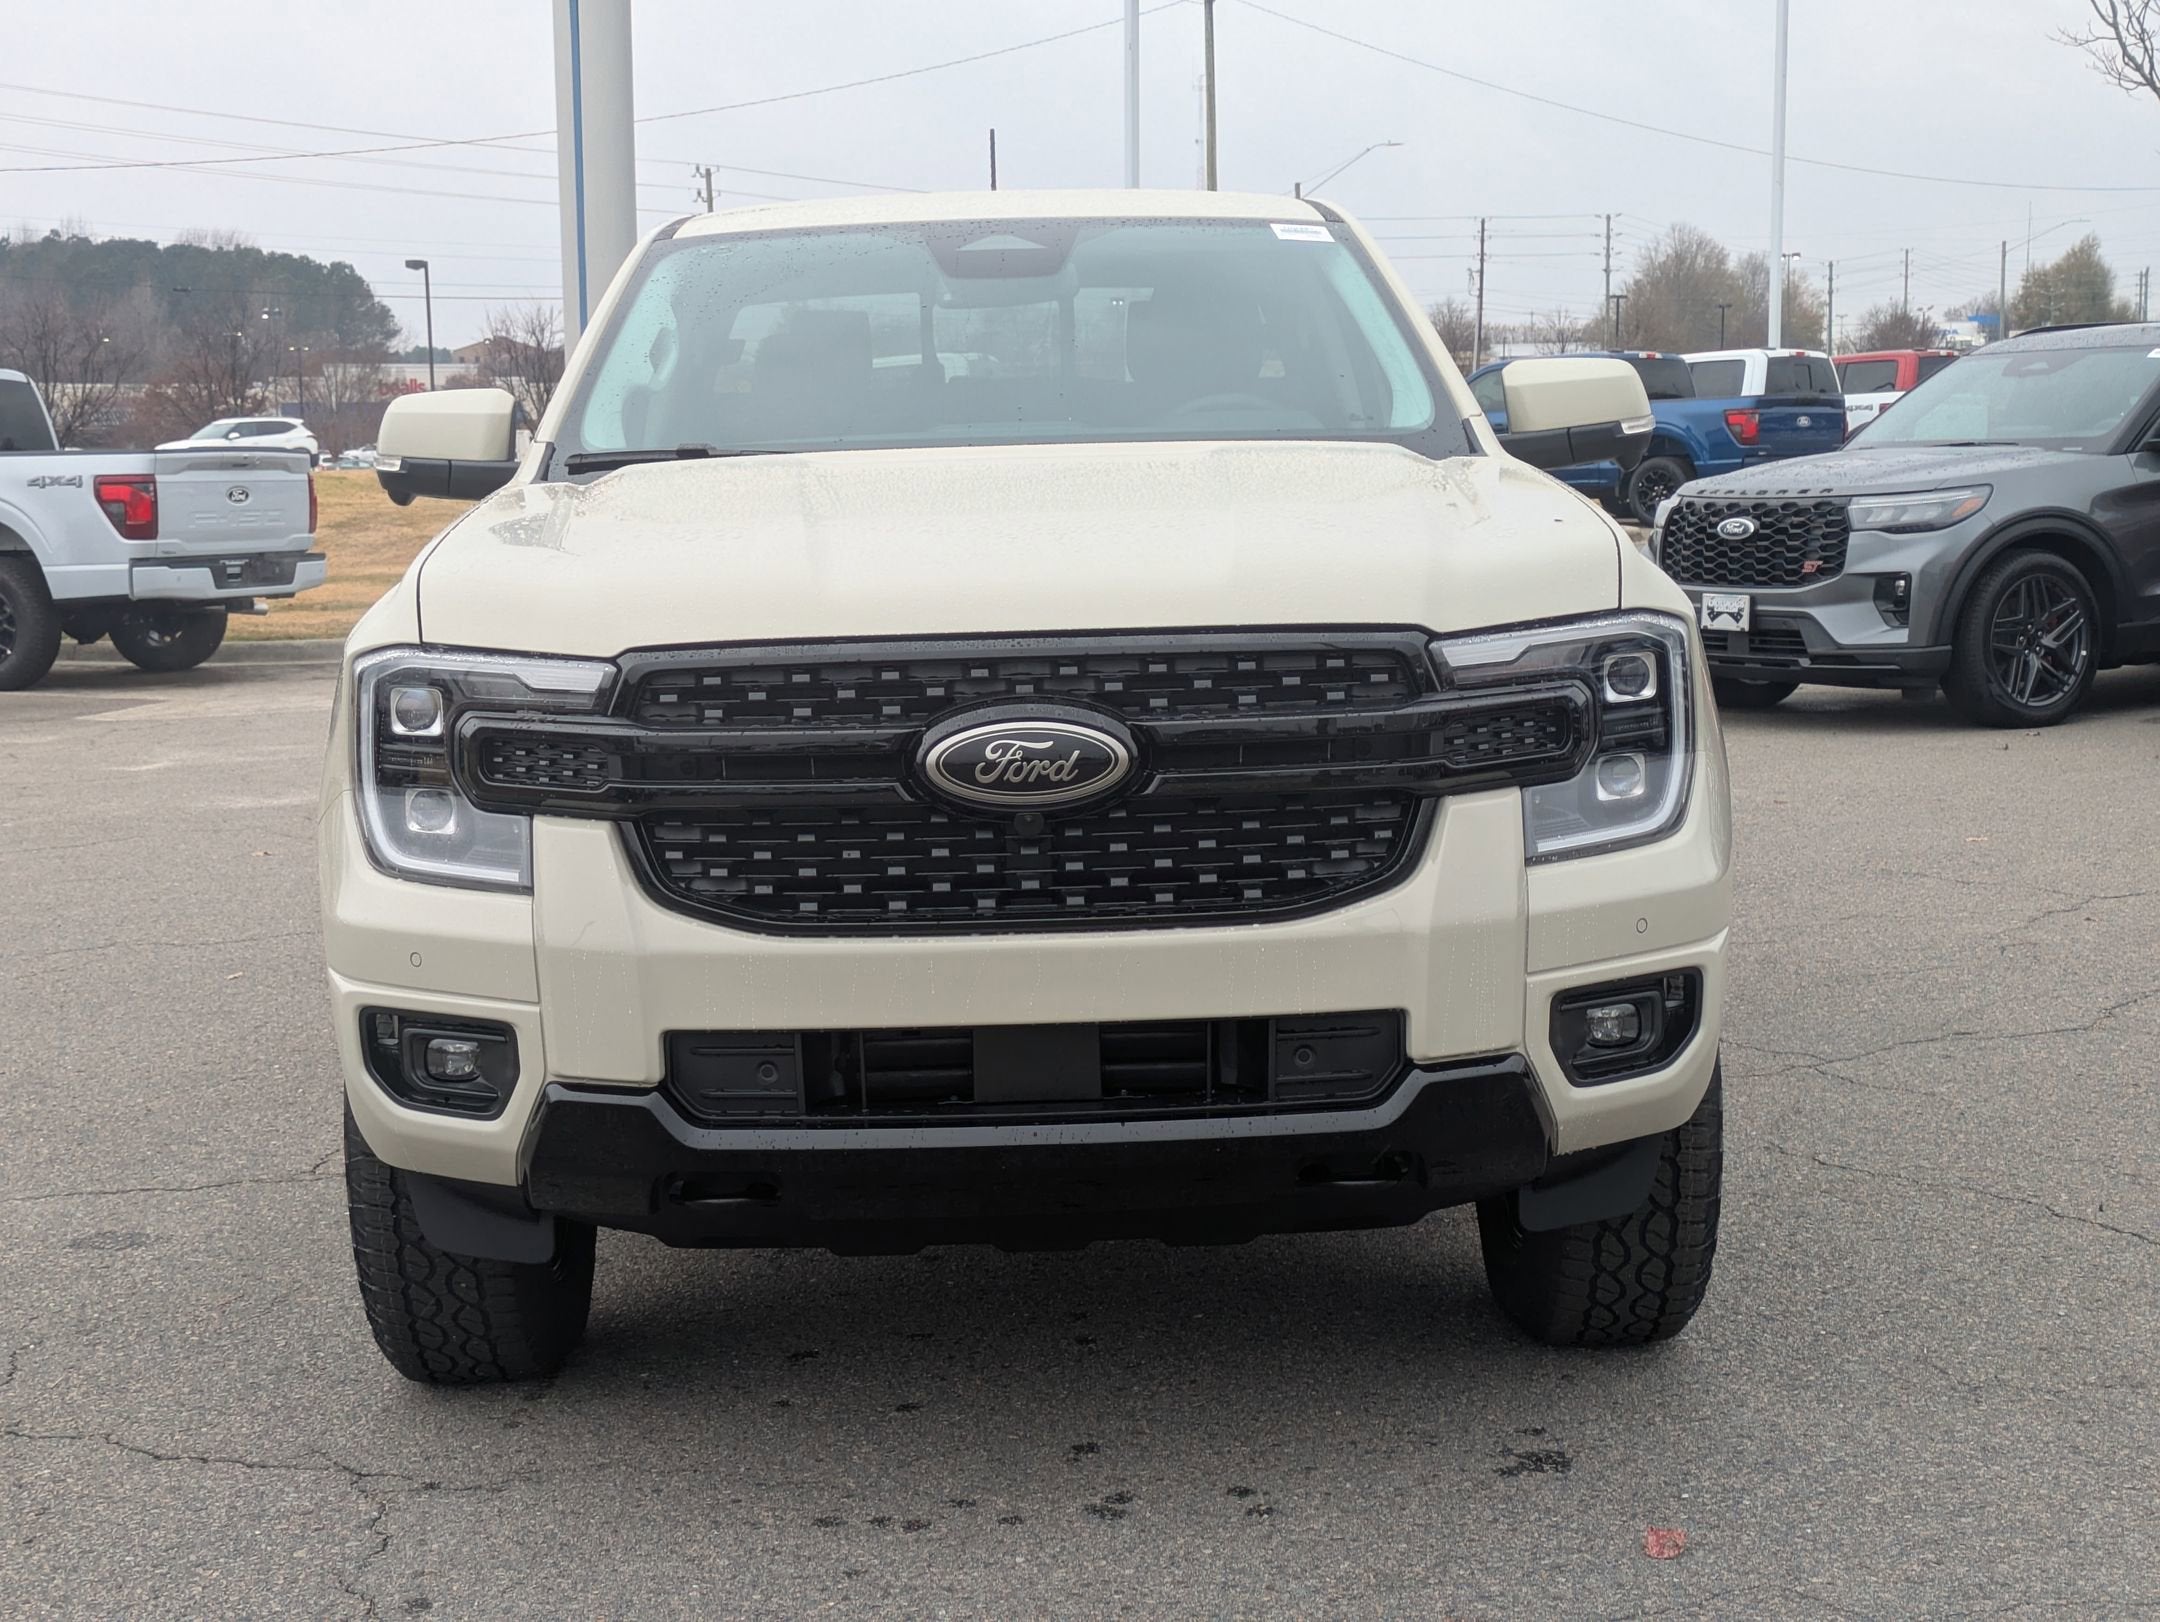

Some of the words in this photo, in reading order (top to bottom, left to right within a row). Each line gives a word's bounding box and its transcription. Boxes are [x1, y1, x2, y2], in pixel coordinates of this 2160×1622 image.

[1696, 487, 1834, 496] EXPLORER
[1723, 522, 1745, 534] Ford
[974, 739, 1081, 784] Ford
